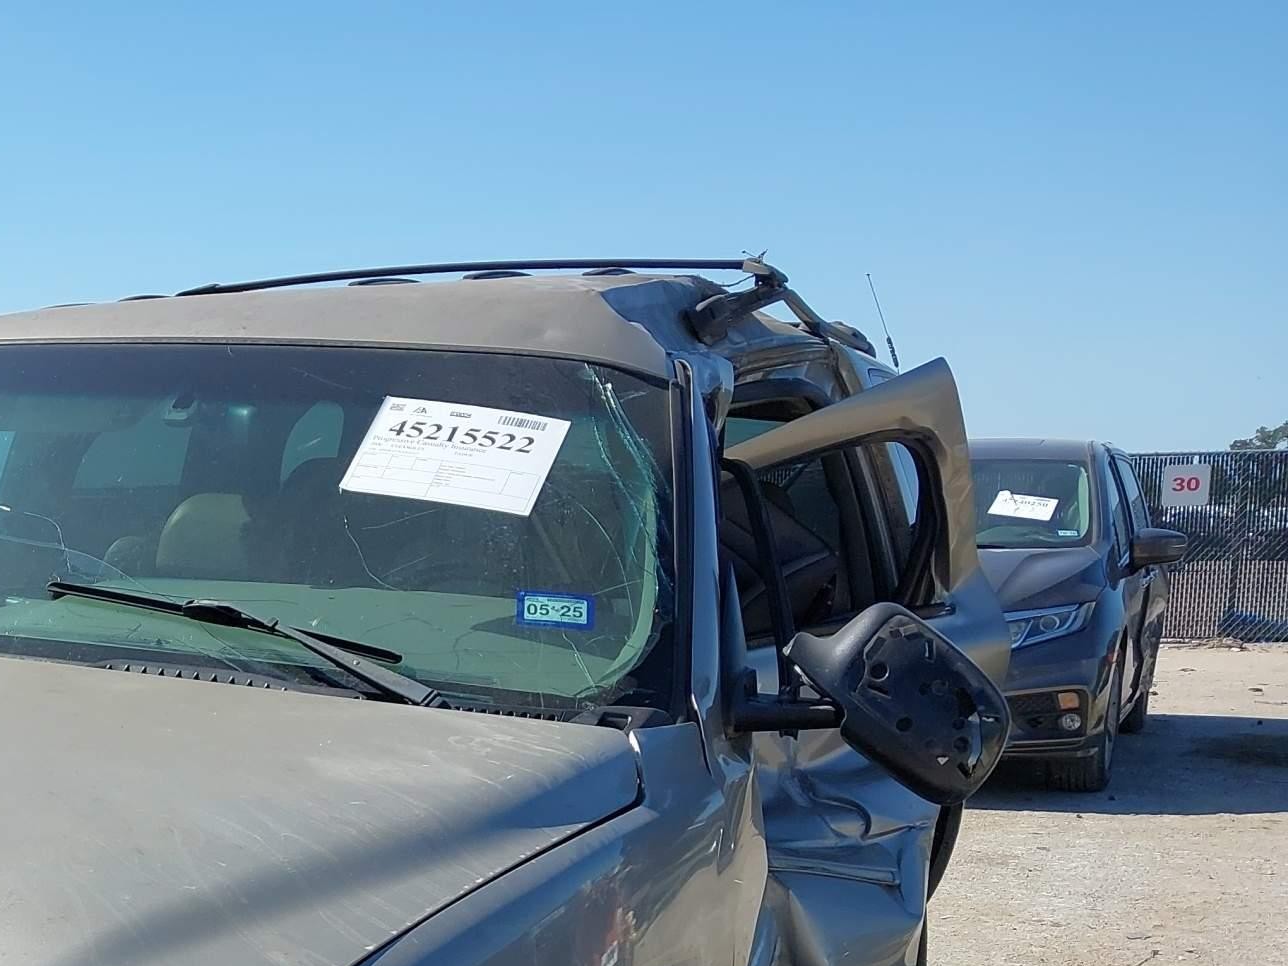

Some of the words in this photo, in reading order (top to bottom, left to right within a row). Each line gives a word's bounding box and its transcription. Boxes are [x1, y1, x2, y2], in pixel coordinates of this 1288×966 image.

[388, 419, 535, 454] 45215522
[1171, 476, 1201, 492] 30
[526, 603, 550, 616] 05
[559, 604, 584, 618] 25
